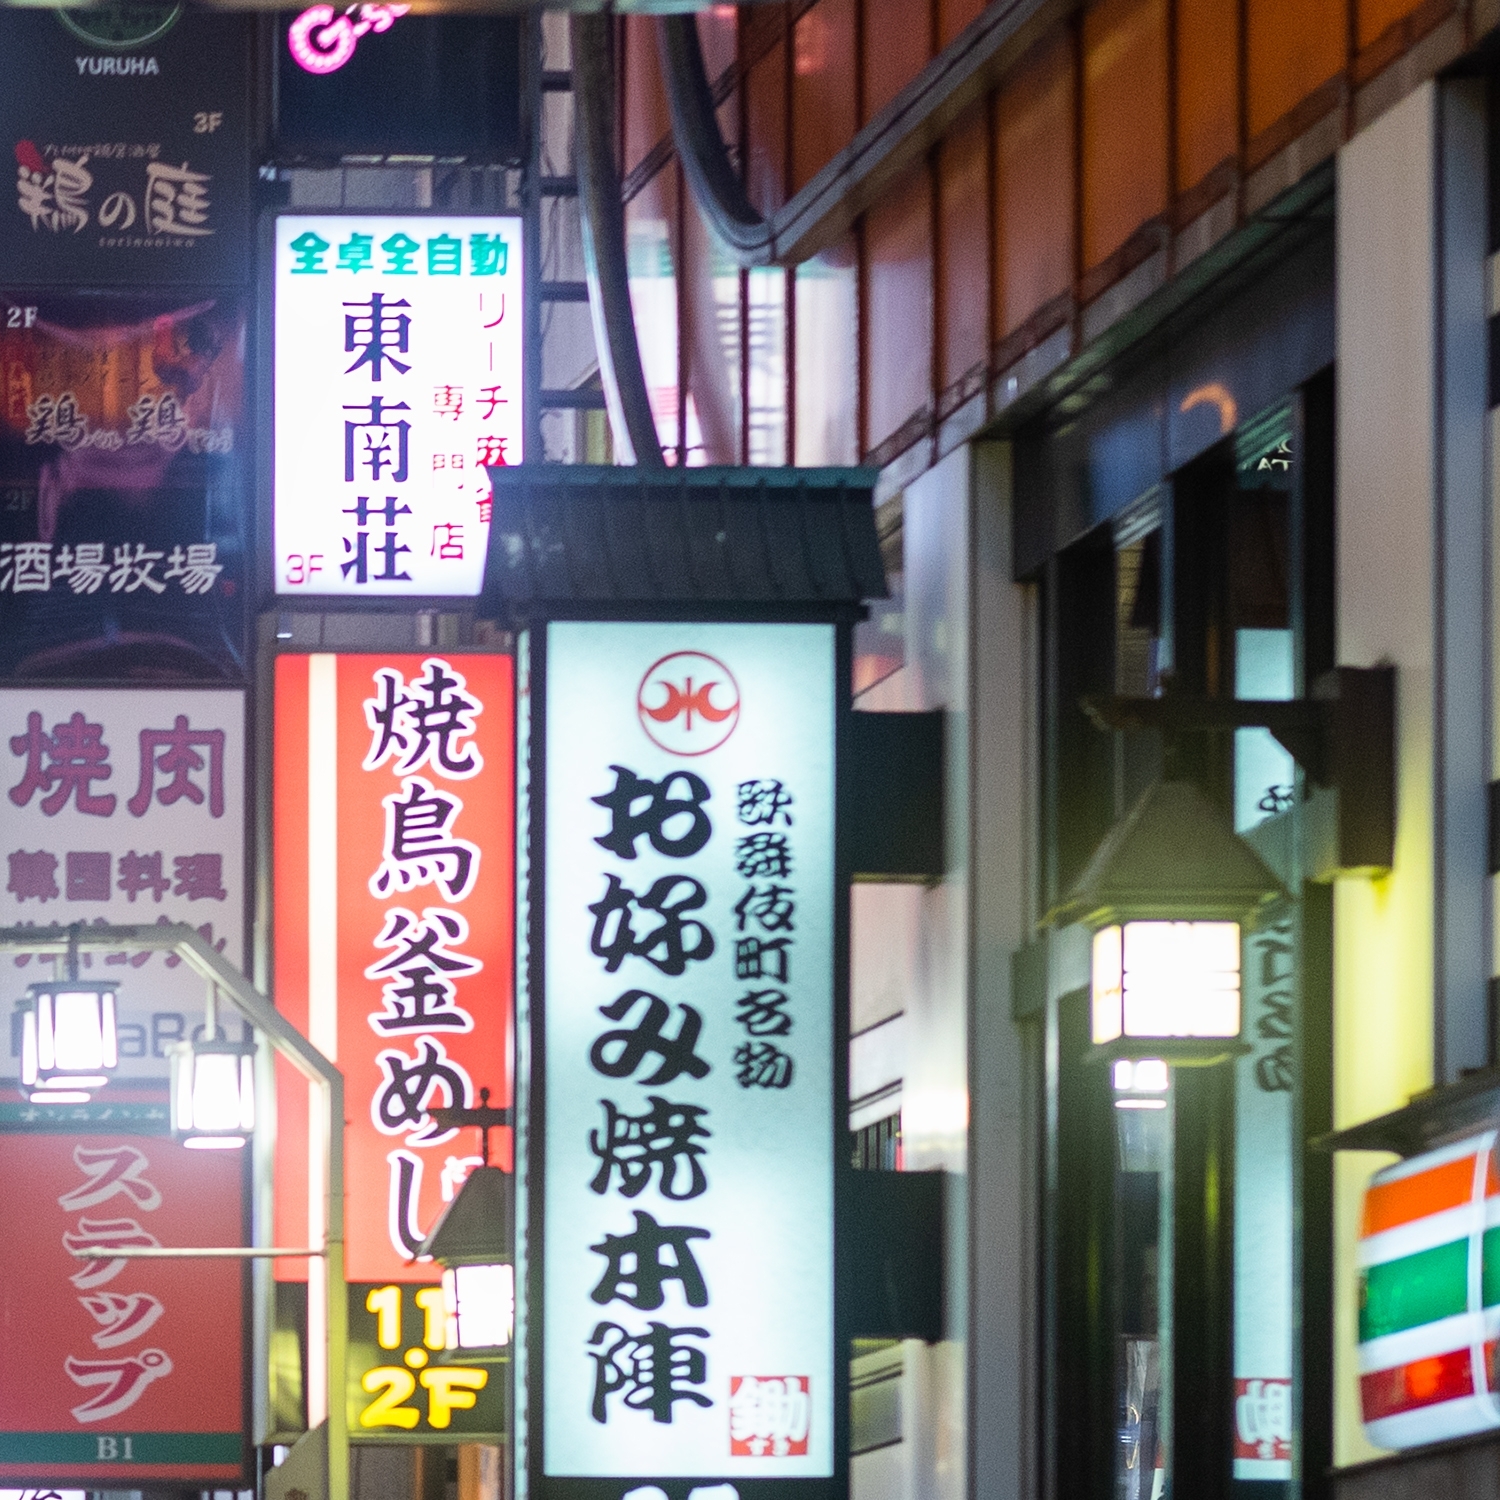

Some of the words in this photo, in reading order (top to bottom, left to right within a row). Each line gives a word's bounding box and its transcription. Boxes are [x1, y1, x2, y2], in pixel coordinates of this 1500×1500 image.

[76, 55, 160, 77] YURUHA
[289, 230, 510, 277] 全卓全自動
[6, 306, 39, 329] 2F
[341, 292, 413, 585] 東南荘
[429, 384, 465, 561] 専門店
[285, 554, 325, 585] 3F
[8, 710, 226, 819] 焼肉
[6, 849, 227, 903] 韓国料理
[732, 776, 797, 1091] 歌舞伎町名物
[587, 765, 718, 1426] お好み焼本陣
[57, 1143, 174, 1424] ステップ
[359, 1365, 489, 1430] 2F
[95, 1436, 135, 1461] B1
